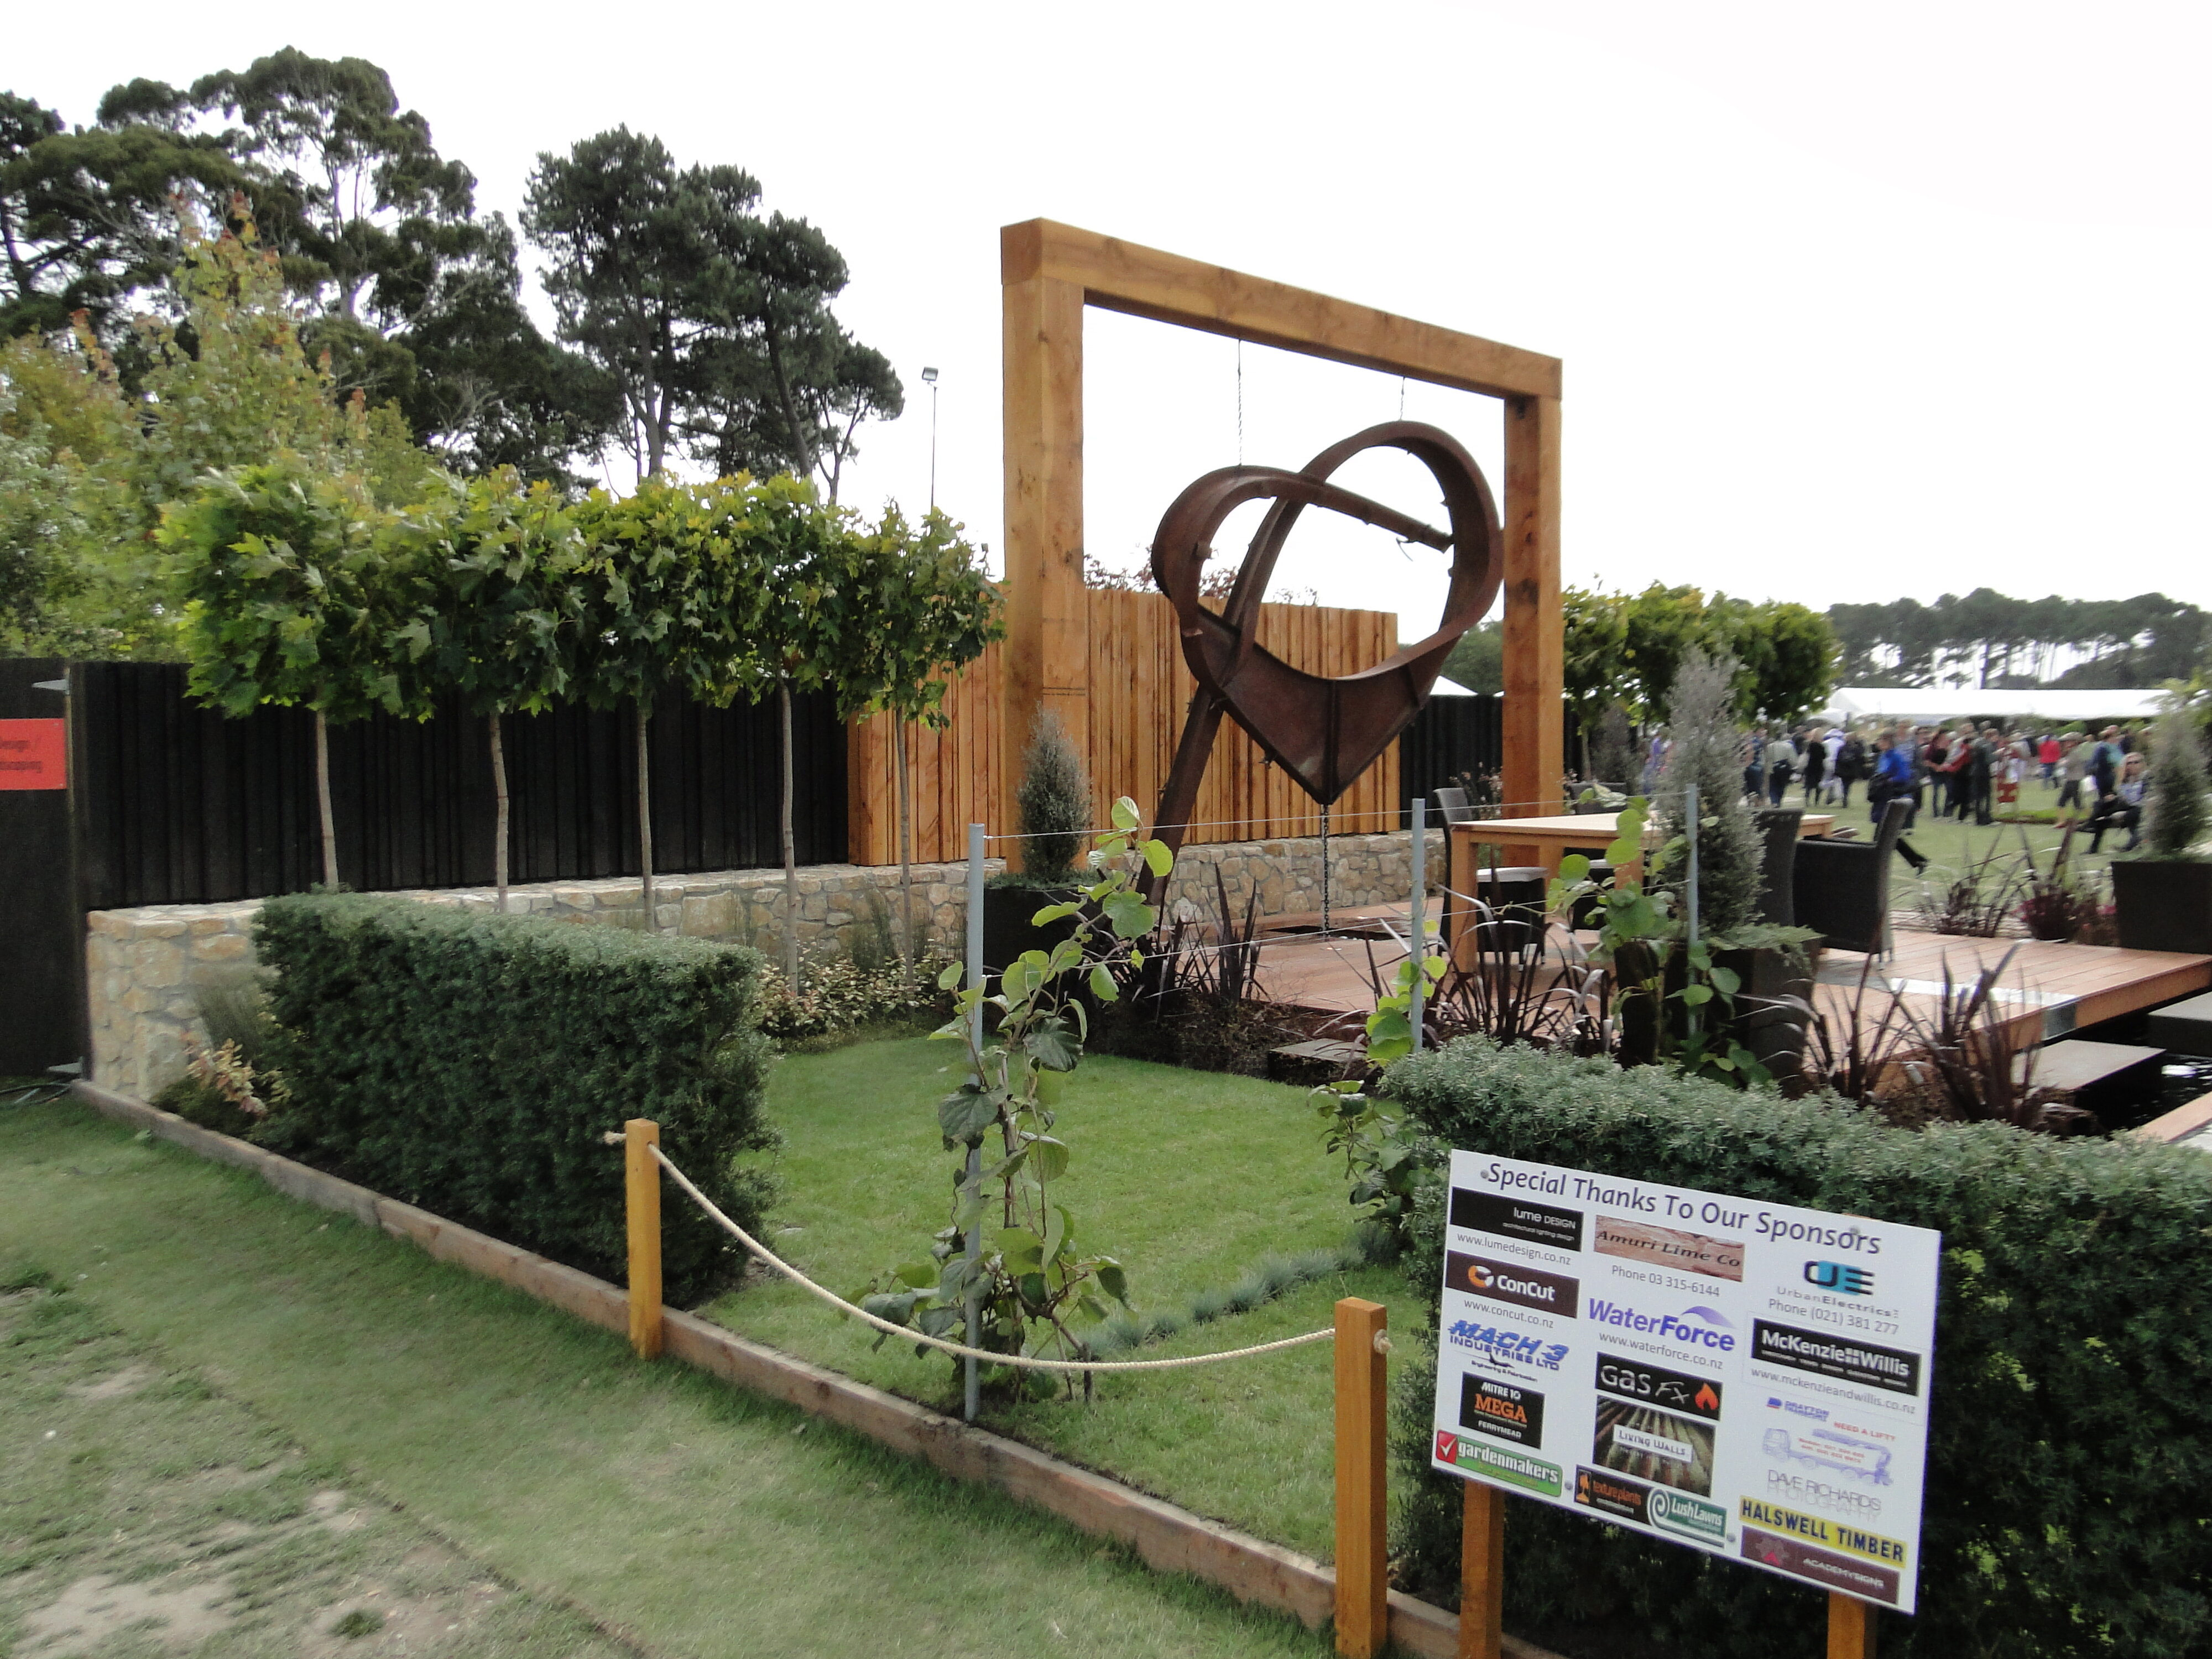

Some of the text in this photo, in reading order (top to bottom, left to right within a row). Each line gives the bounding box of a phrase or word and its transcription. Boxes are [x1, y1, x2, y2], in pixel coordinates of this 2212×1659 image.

[1488, 1163, 1881, 1254] Special Thanks To Our Sponsors
[1514, 1207, 1575, 1229] lume DESIGN
[1457, 1233, 1571, 1265] www.lumedesign.co.nz
[1596, 1230, 1740, 1267] Amuri Lime Co
[1497, 1275, 1555, 1301] ConCut
[1612, 1265, 1720, 1297] Phone 03 315-6144
[1464, 1300, 1553, 1328] www.concut.co.nz
[1769, 1298, 1899, 1335] Phone (021) 381 277
[1777, 1286, 1892, 1317] UrbanElectrics
[1448, 1319, 1569, 1361] MACH 3
[1589, 1298, 1735, 1351] WaterForce
[1449, 1335, 1559, 1370] INDUSTRIES LTD
[1599, 1332, 1723, 1369] www.waterforce.co.nz
[1762, 1329, 1845, 1363] McKenzie
[1860, 1350, 1910, 1376] Willis
[1474, 1393, 1527, 1423] MEGA
[1481, 1381, 1522, 1400] MITRE 10
[1751, 1368, 1916, 1414] www.mckenzieandwillis.co.nz
[1478, 1420, 1522, 1439] FERRYMEAD
[1834, 1421, 1859, 1433] NEED
[1458, 1441, 1558, 1483] gardenmakers
[1742, 1498, 1903, 1562] HALSWELL TIMBER
